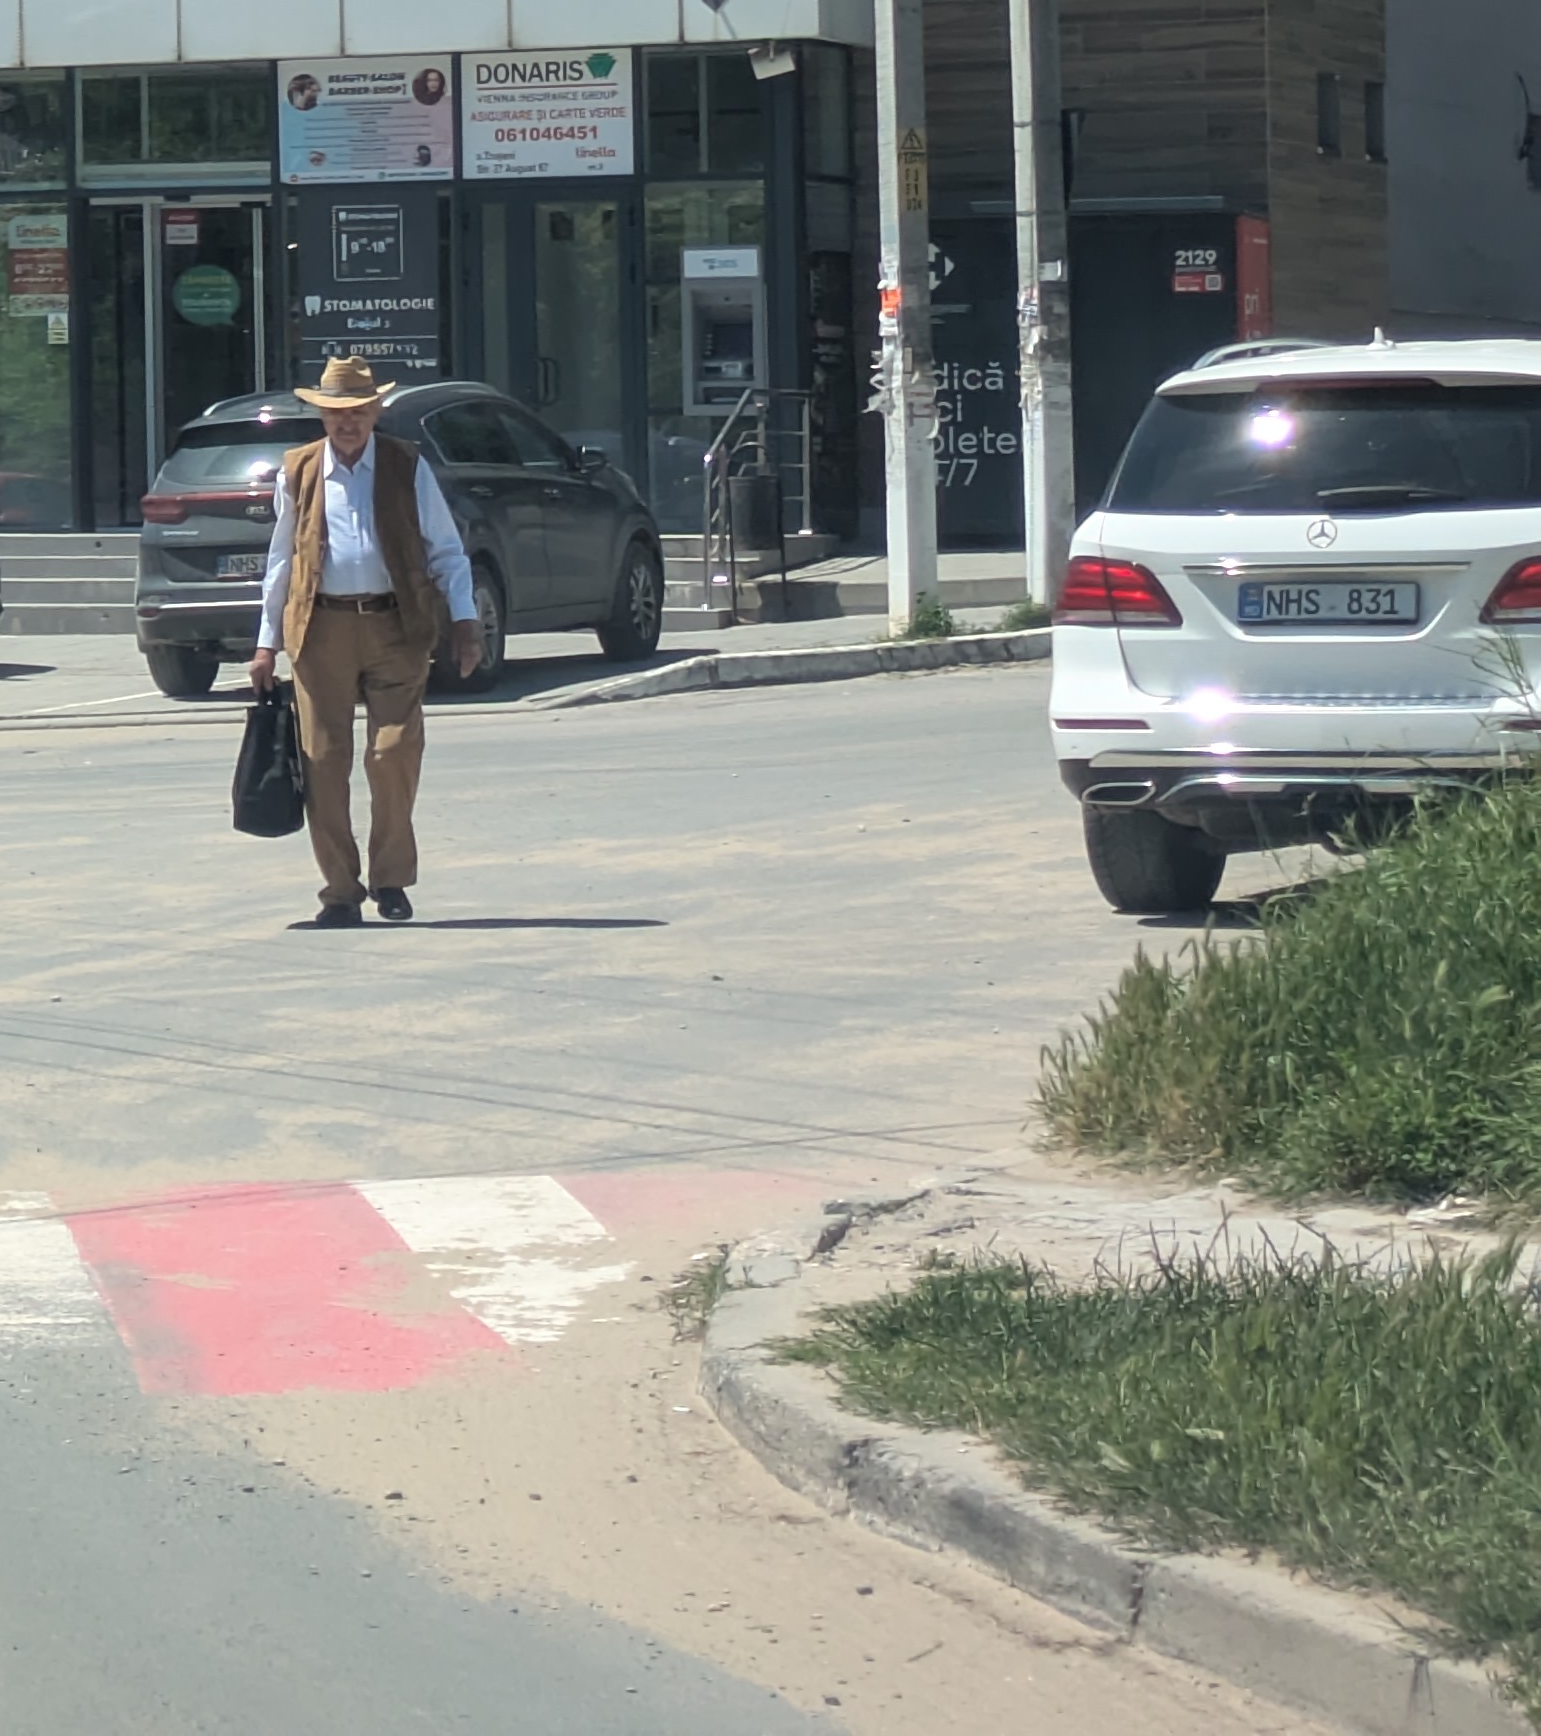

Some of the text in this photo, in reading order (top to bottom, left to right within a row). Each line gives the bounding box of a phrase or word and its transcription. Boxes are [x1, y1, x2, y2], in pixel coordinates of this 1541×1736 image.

[476, 61, 584, 84] DONARIS
[477, 94, 516, 104] VIENNA
[581, 90, 618, 101] GROUP
[470, 109, 533, 122] ASIGURARE
[549, 108, 586, 120] CARTE
[589, 106, 626, 119] VERDE
[494, 125, 598, 142] 061046451
[1175, 250, 1217, 266] 2129
[323, 298, 435, 312] STOMATOLOGIE
[1267, 588, 1321, 616] NHS
[1347, 588, 1399, 615] 831
